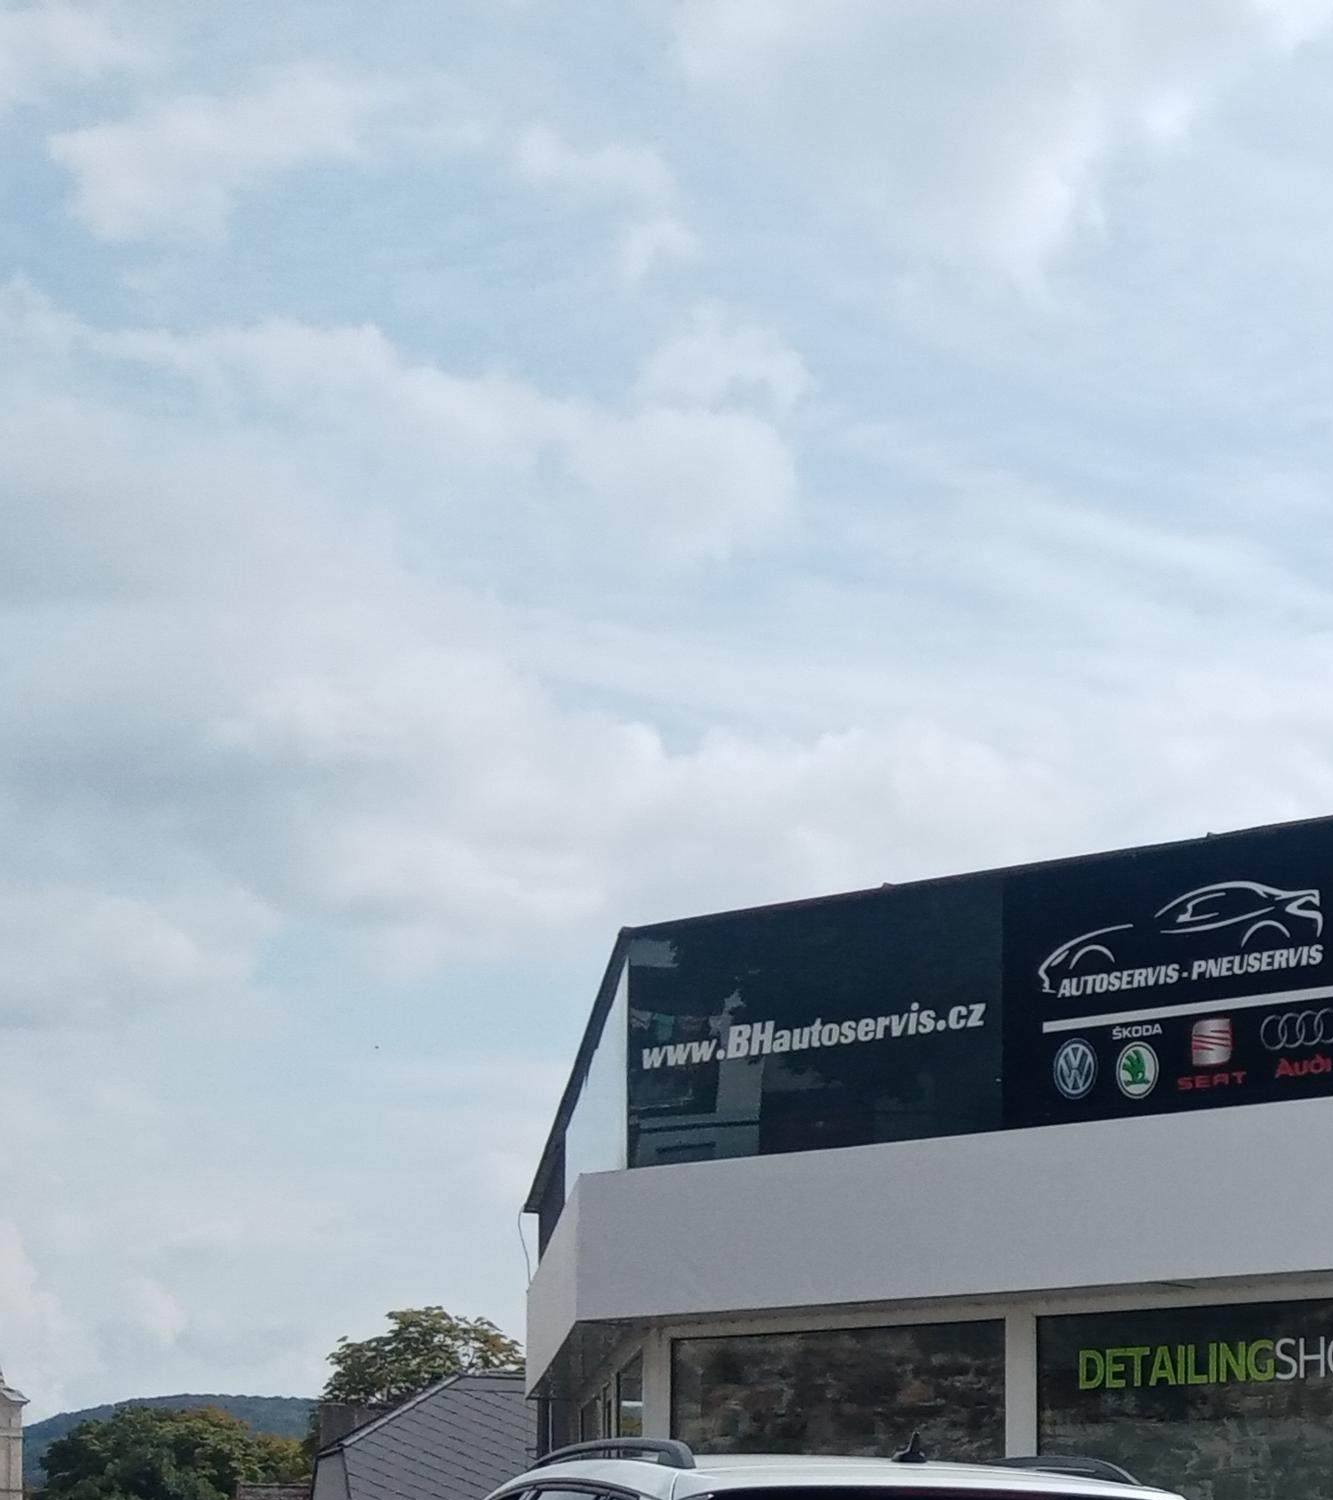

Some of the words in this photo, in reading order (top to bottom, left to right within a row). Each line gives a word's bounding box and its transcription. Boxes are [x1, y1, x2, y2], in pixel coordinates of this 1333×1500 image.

[1057, 963, 1180, 998] AUTOSERVIS
[1191, 944, 1324, 981] PNEUSERVIS
[641, 1002, 987, 1070] www.BHautoservis.cz
[1112, 1023, 1163, 1041] ŠKODA
[1275, 1054, 1333, 1078] Audi
[1177, 1071, 1247, 1090] SEAT
